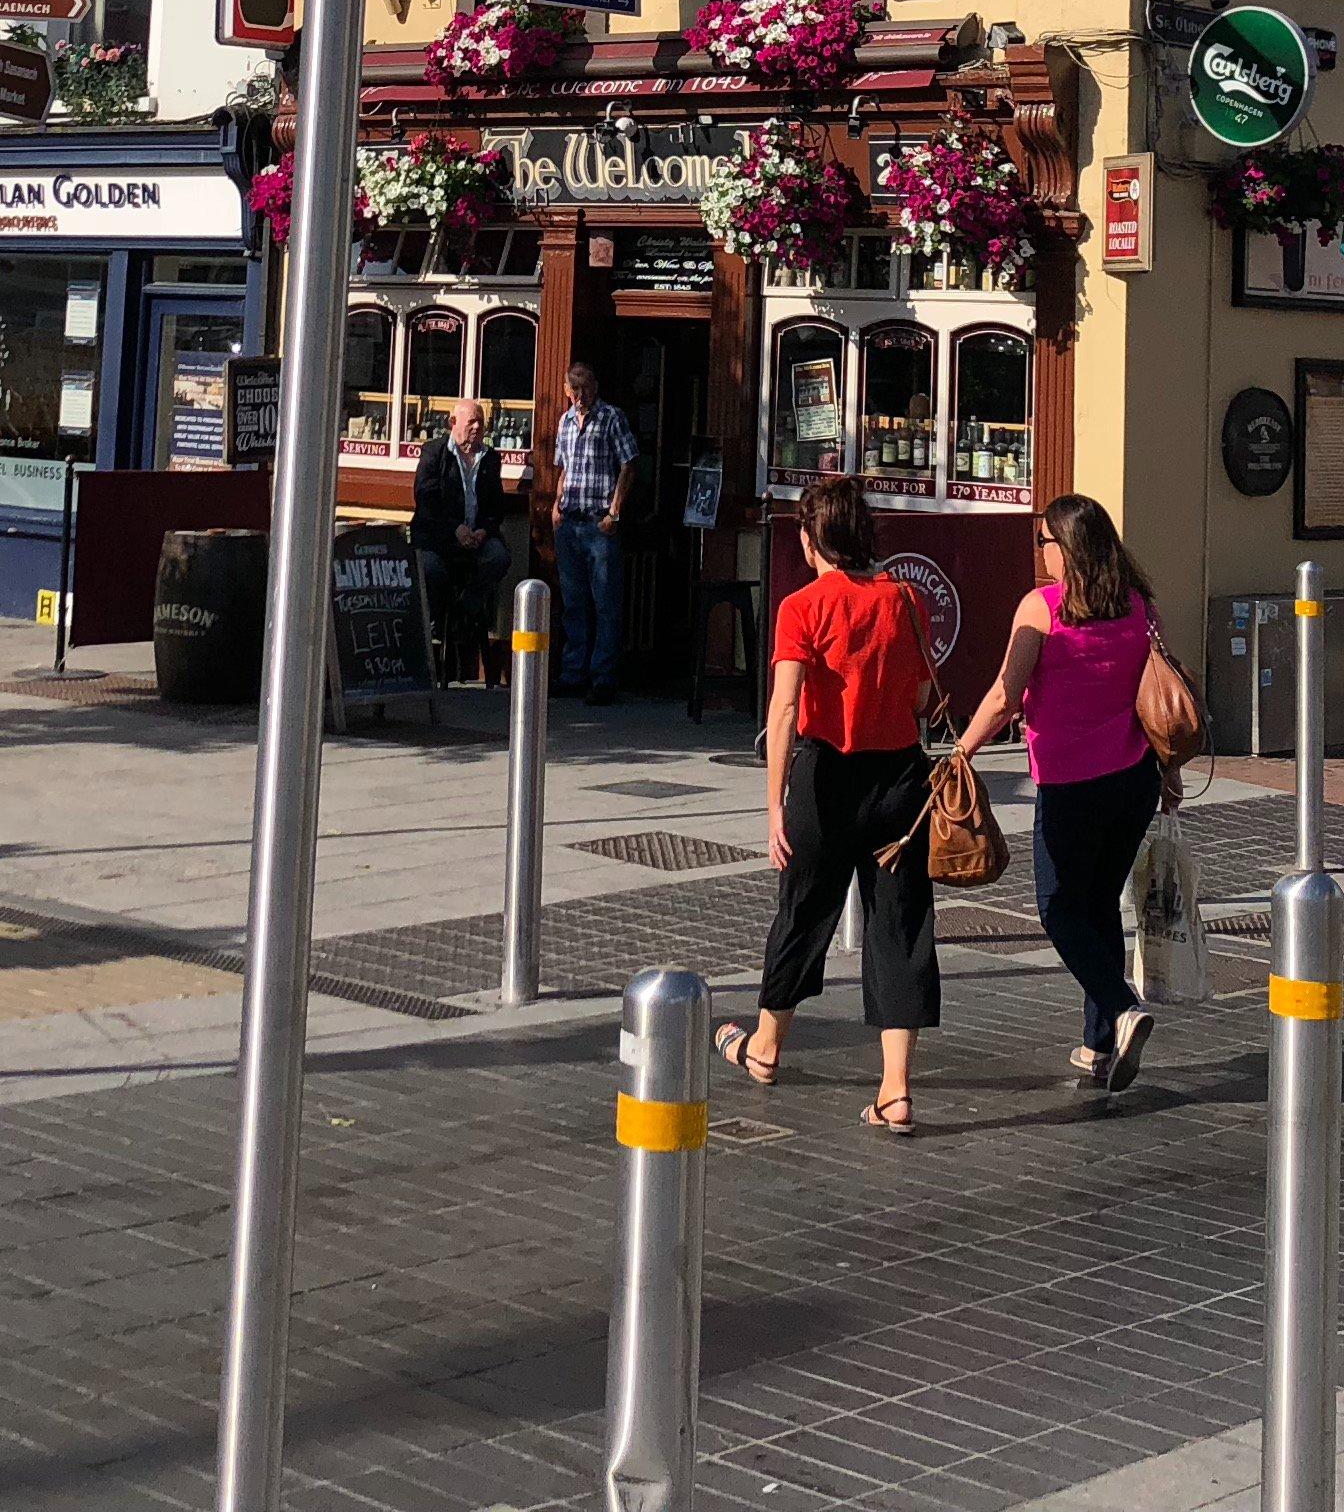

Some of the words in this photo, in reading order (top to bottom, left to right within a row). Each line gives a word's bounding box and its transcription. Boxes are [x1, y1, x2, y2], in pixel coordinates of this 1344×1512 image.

[1204, 42, 1294, 105] Carlsberg
[1216, 94, 1264, 119] COPENHAGEN
[482, 128, 562, 190] The
[563, 133, 729, 190] Welcome
[52, 174, 161, 209] GOLDEN
[1108, 221, 1137, 234] ROASTED
[1108, 237, 1137, 250] LOCALLY
[237, 388, 279, 404] CHOOS
[342, 441, 386, 456] SERVING
[501, 452, 526, 465] EARS!
[14, 464, 63, 481] BUSINESS
[865, 477, 899, 492] CORK
[902, 481, 926, 494] FOR
[952, 485, 971, 498] 170
[973, 486, 1017, 502] YEARS!
[334, 559, 370, 588] LIVE
[371, 558, 412, 588] MUSIC
[931, 637, 948, 660] LE
